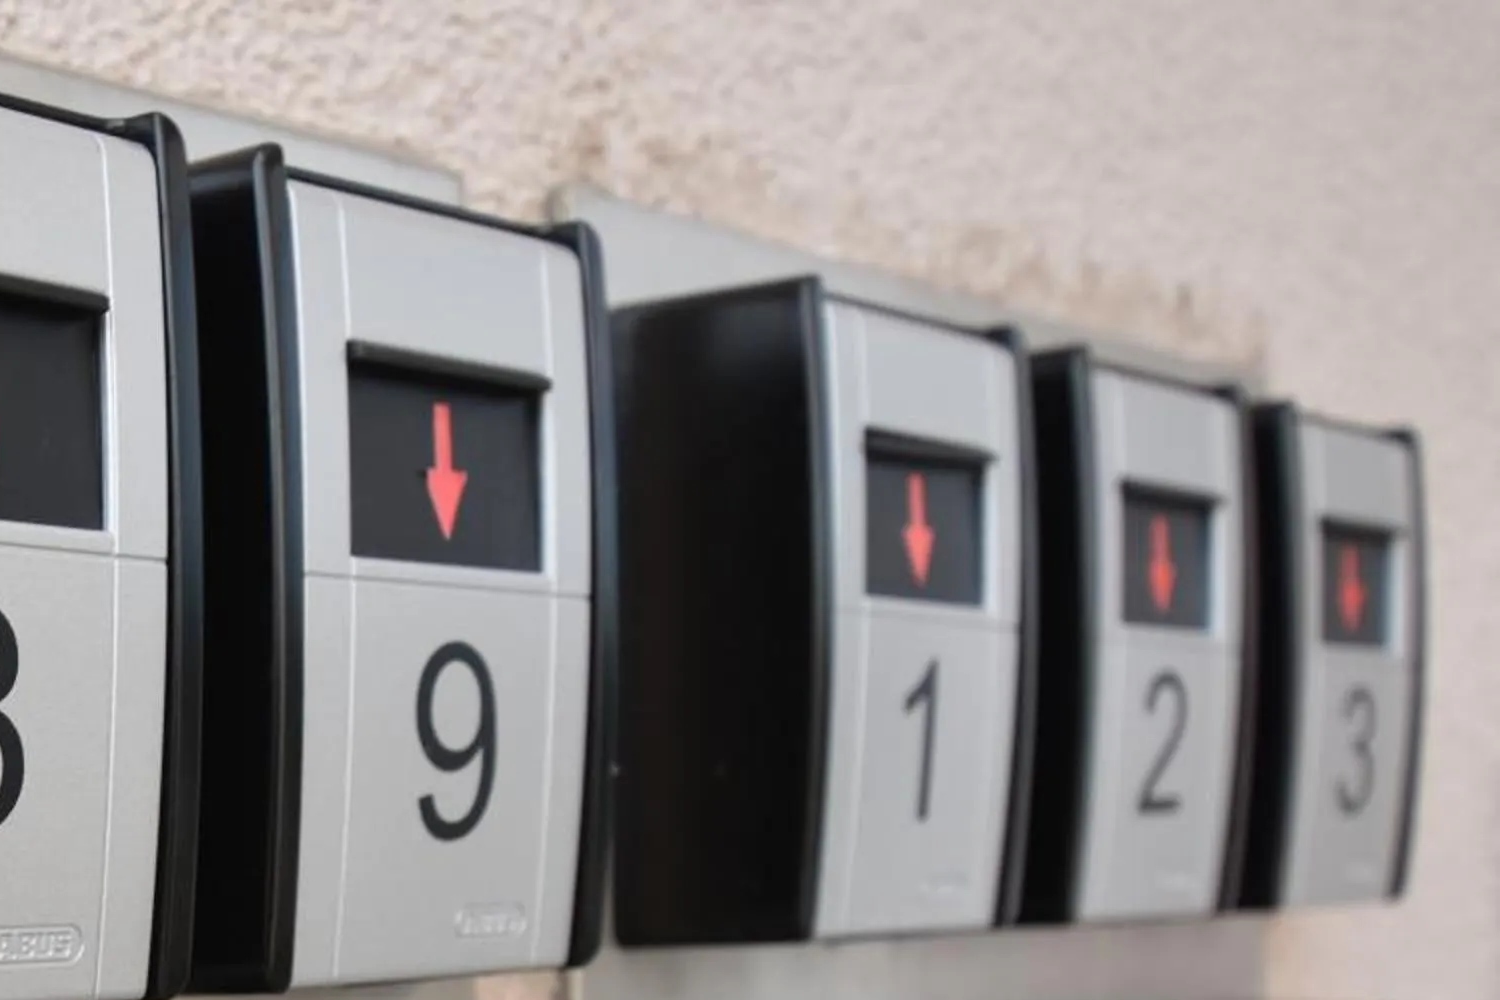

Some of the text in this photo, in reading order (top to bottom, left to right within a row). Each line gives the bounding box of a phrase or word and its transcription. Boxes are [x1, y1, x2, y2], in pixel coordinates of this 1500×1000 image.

[414, 639, 498, 843] 9
[901, 658, 940, 824] 1
[1134, 669, 1190, 818] 2
[1334, 683, 1377, 819] 3
